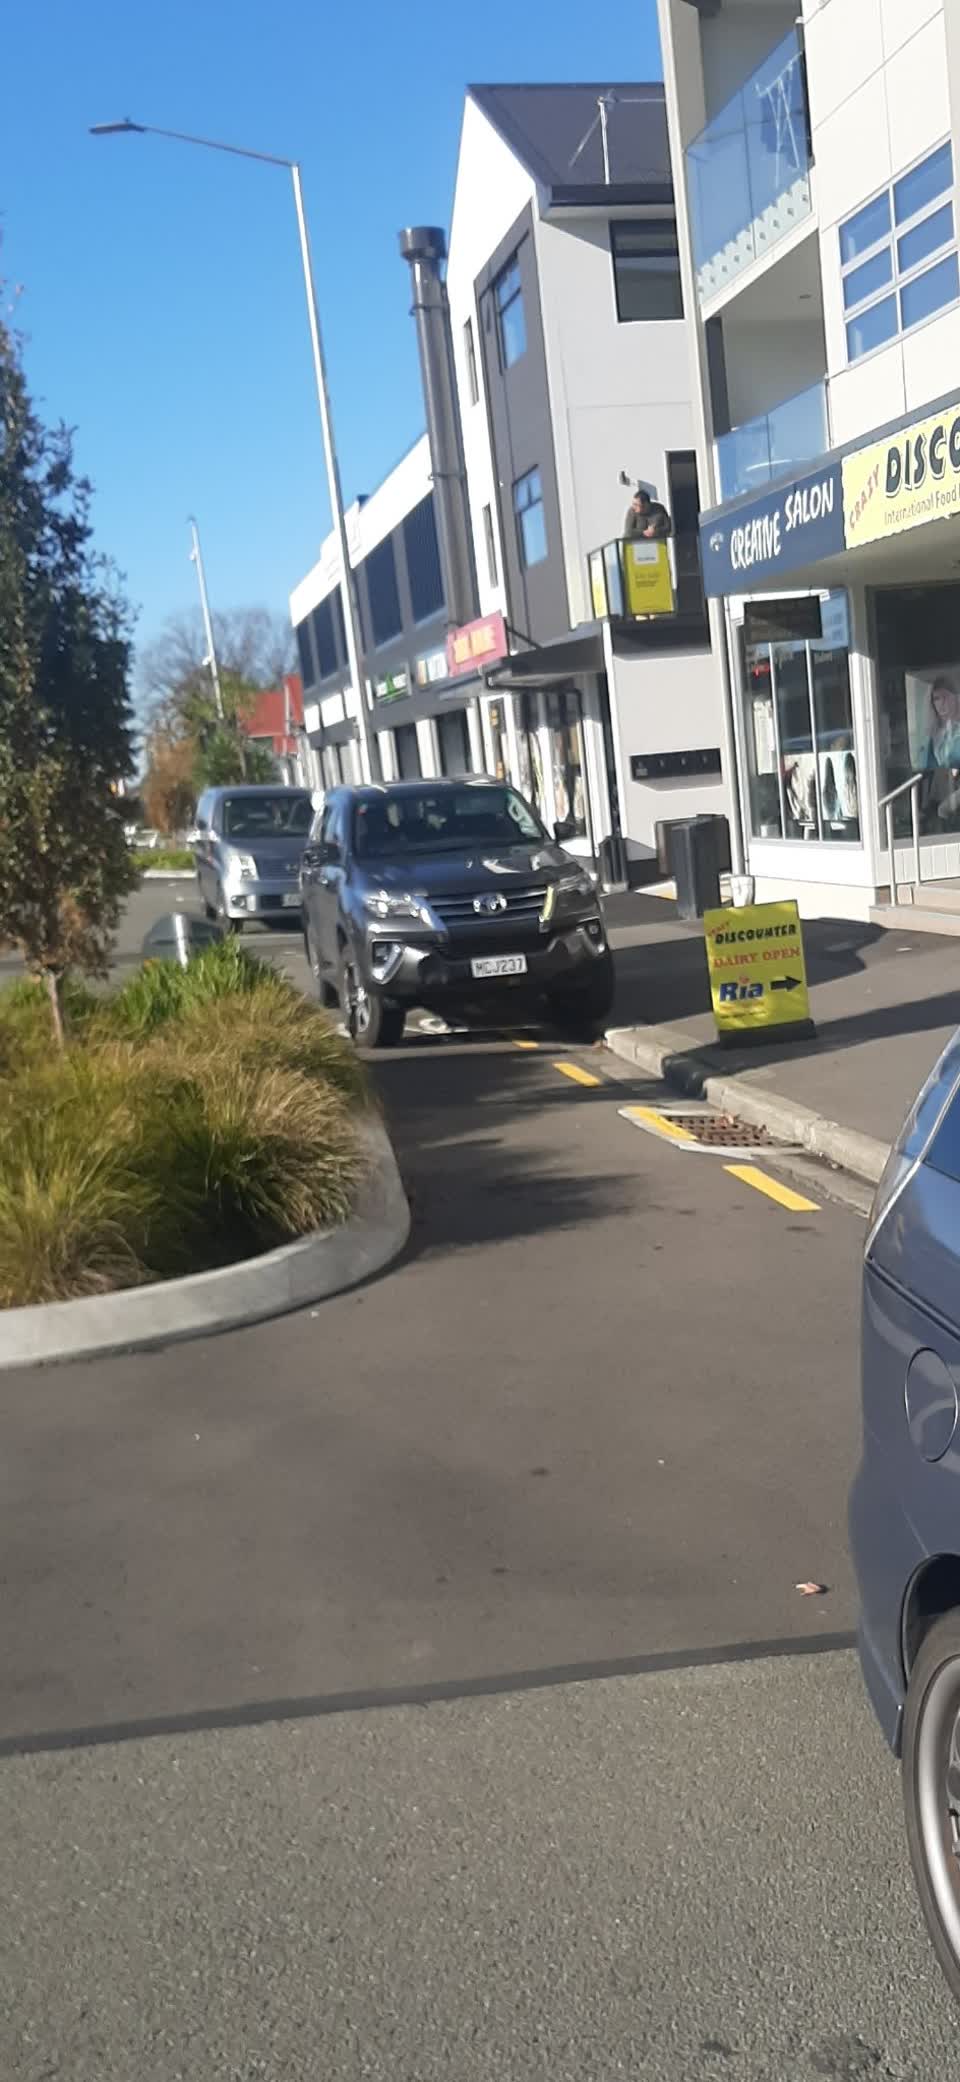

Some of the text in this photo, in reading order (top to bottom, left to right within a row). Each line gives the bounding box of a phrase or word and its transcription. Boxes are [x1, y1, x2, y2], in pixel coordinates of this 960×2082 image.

[885, 492, 935, 525] International
[936, 486, 957, 508] Food
[731, 478, 834, 570] CREATIVE SALON
[715, 924, 796, 944] DISCOUNTER
[713, 947, 801, 968] DAIRY OPEN
[720, 977, 763, 1001] Ria
